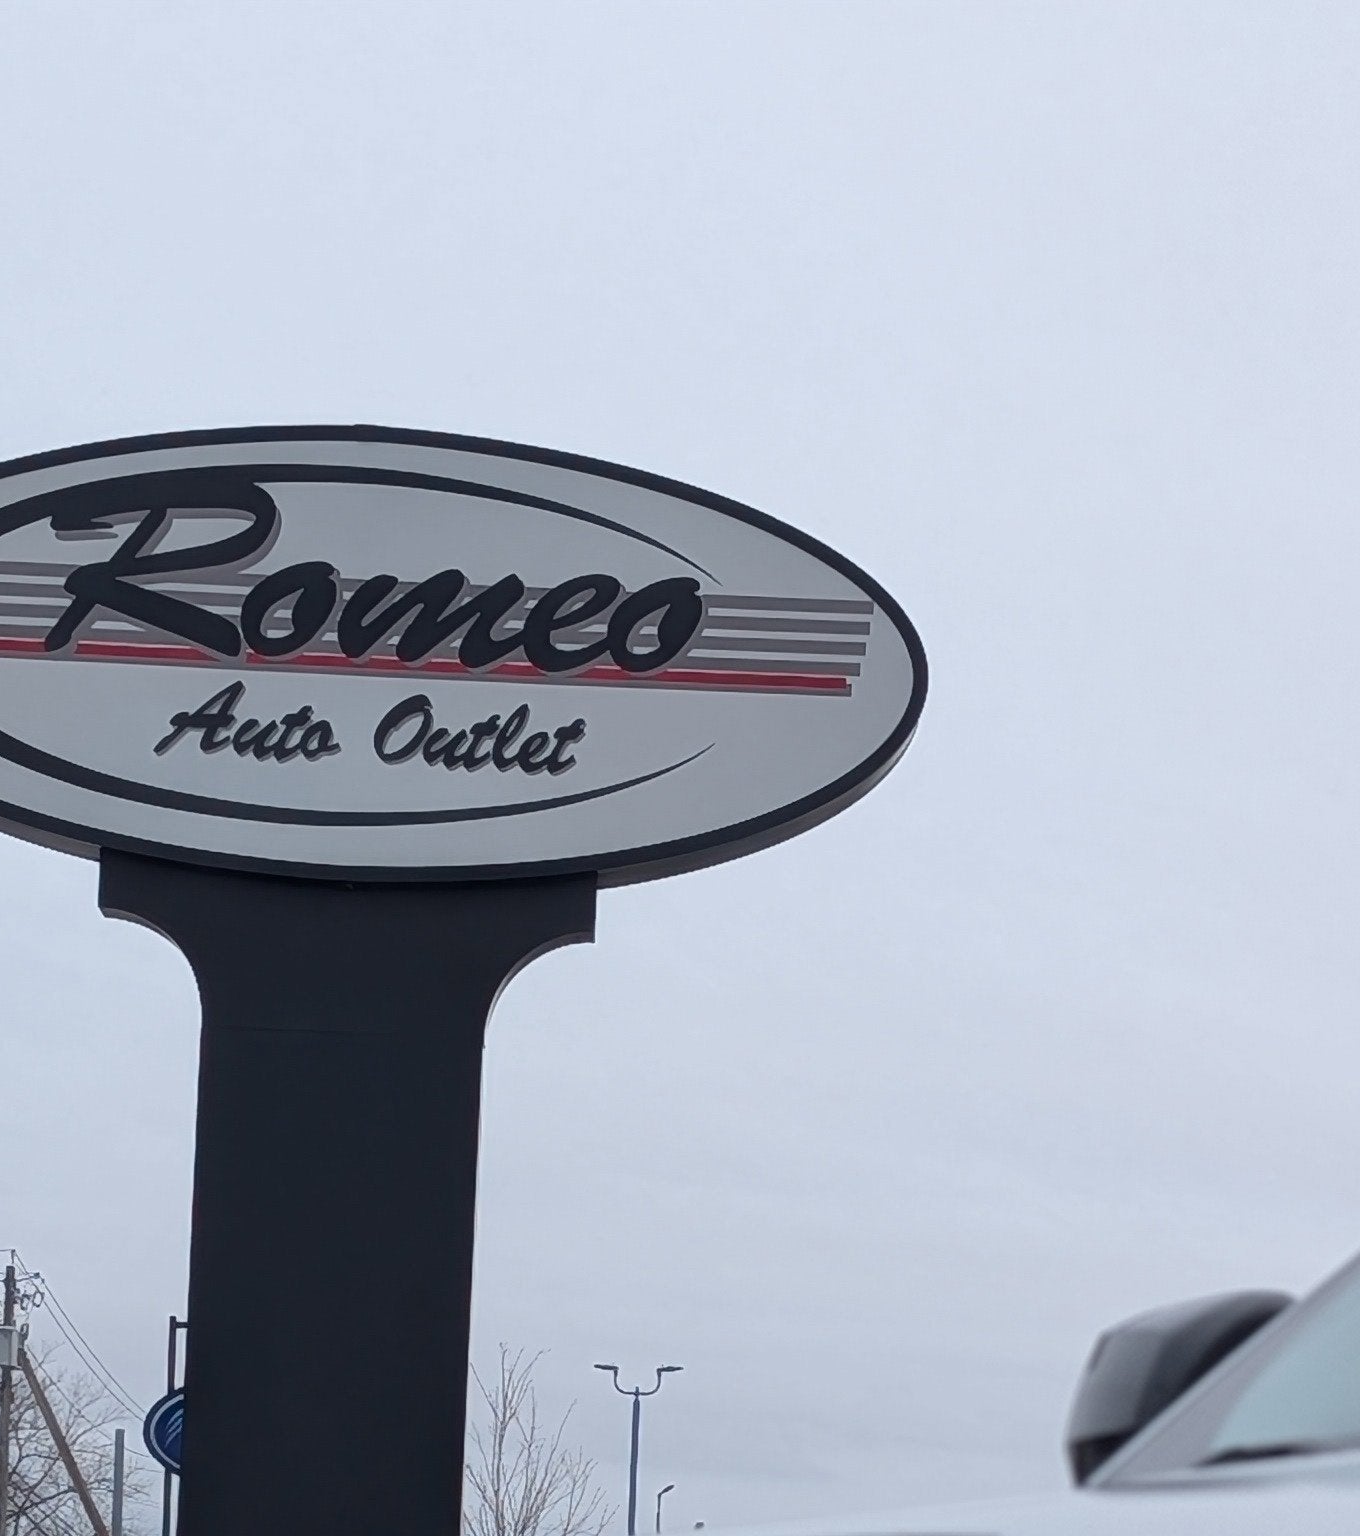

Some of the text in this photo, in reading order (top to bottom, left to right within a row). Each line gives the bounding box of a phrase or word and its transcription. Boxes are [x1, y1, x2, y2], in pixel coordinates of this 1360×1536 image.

[44, 480, 703, 673] Romeo
[153, 679, 587, 776] Auto Outlet
